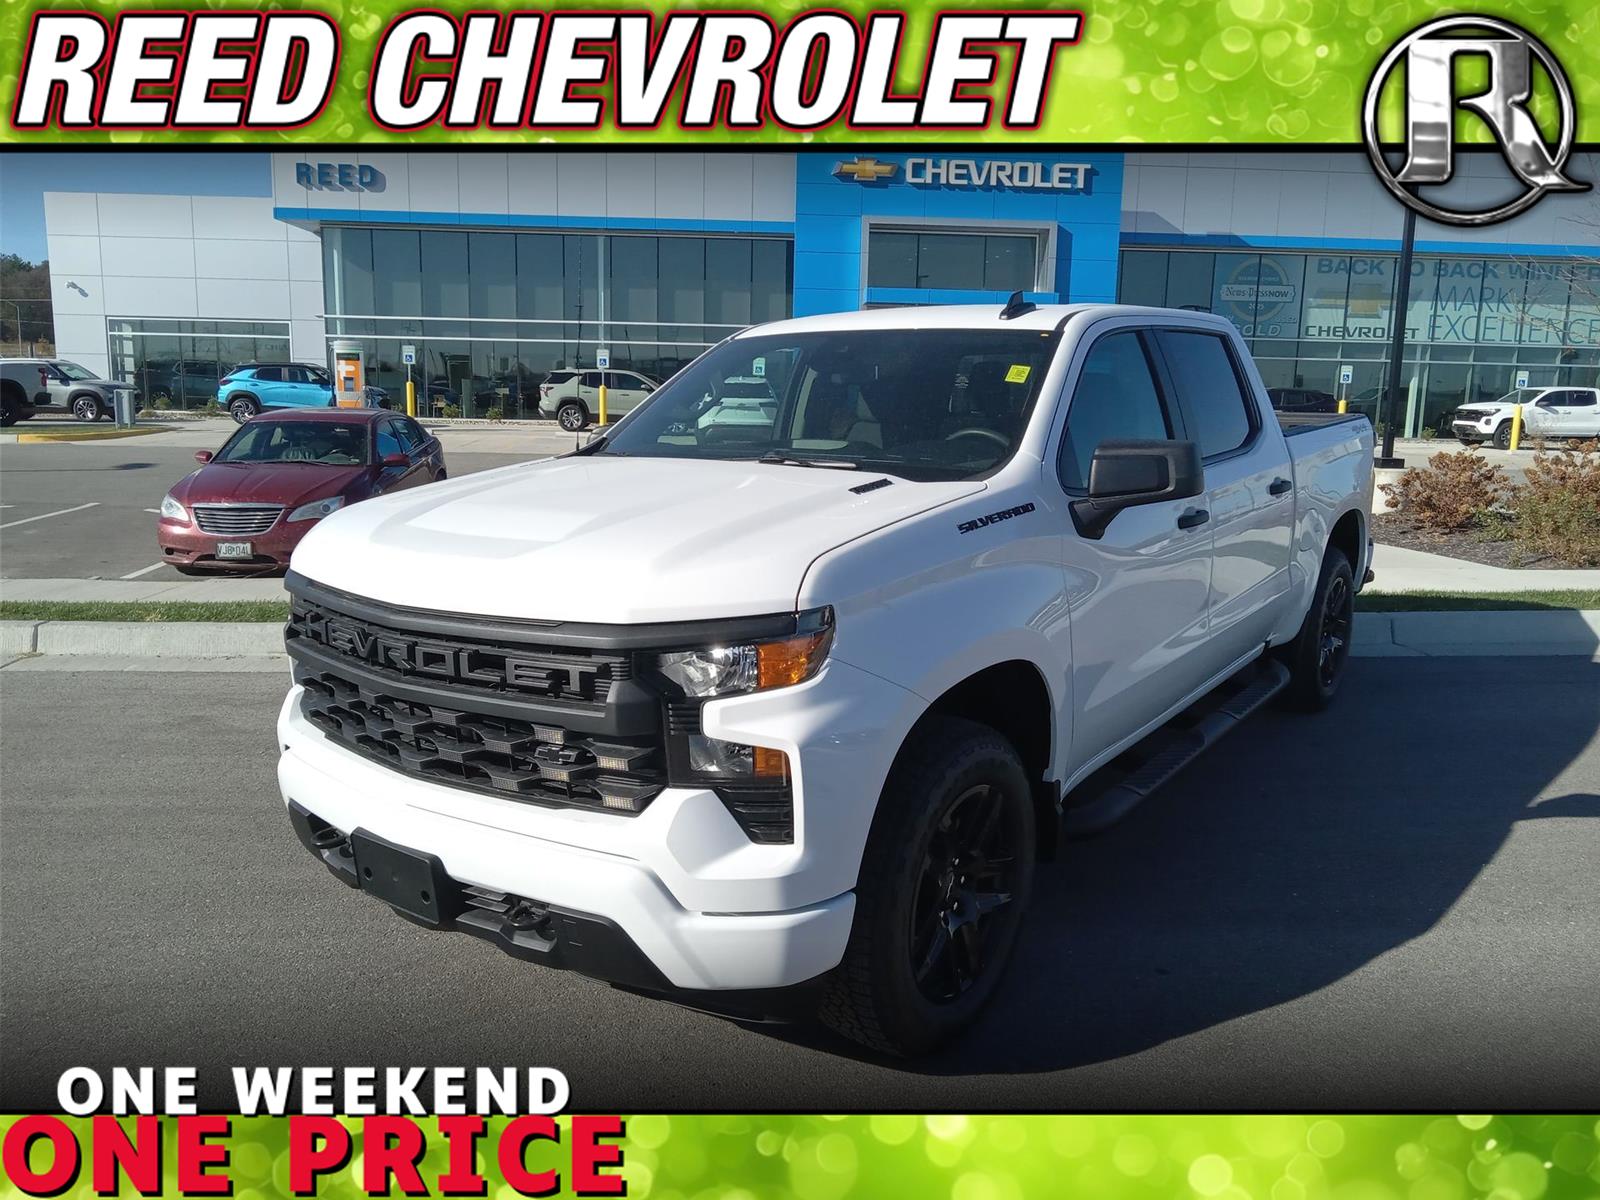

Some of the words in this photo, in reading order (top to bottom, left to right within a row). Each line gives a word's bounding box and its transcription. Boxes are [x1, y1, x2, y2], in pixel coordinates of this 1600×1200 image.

[295, 162, 375, 188] REED
[904, 157, 1092, 189] CHEVROLET
[1317, 259, 1385, 275] BACK
[1433, 263, 1498, 280] BACK
[1430, 286, 1513, 313] MARK
[1305, 325, 1420, 339] CHEVROT
[1427, 315, 1600, 344] EXCELLENCE
[957, 502, 1036, 535] SILVERADO
[292, 607, 599, 693] CHEVROLET
